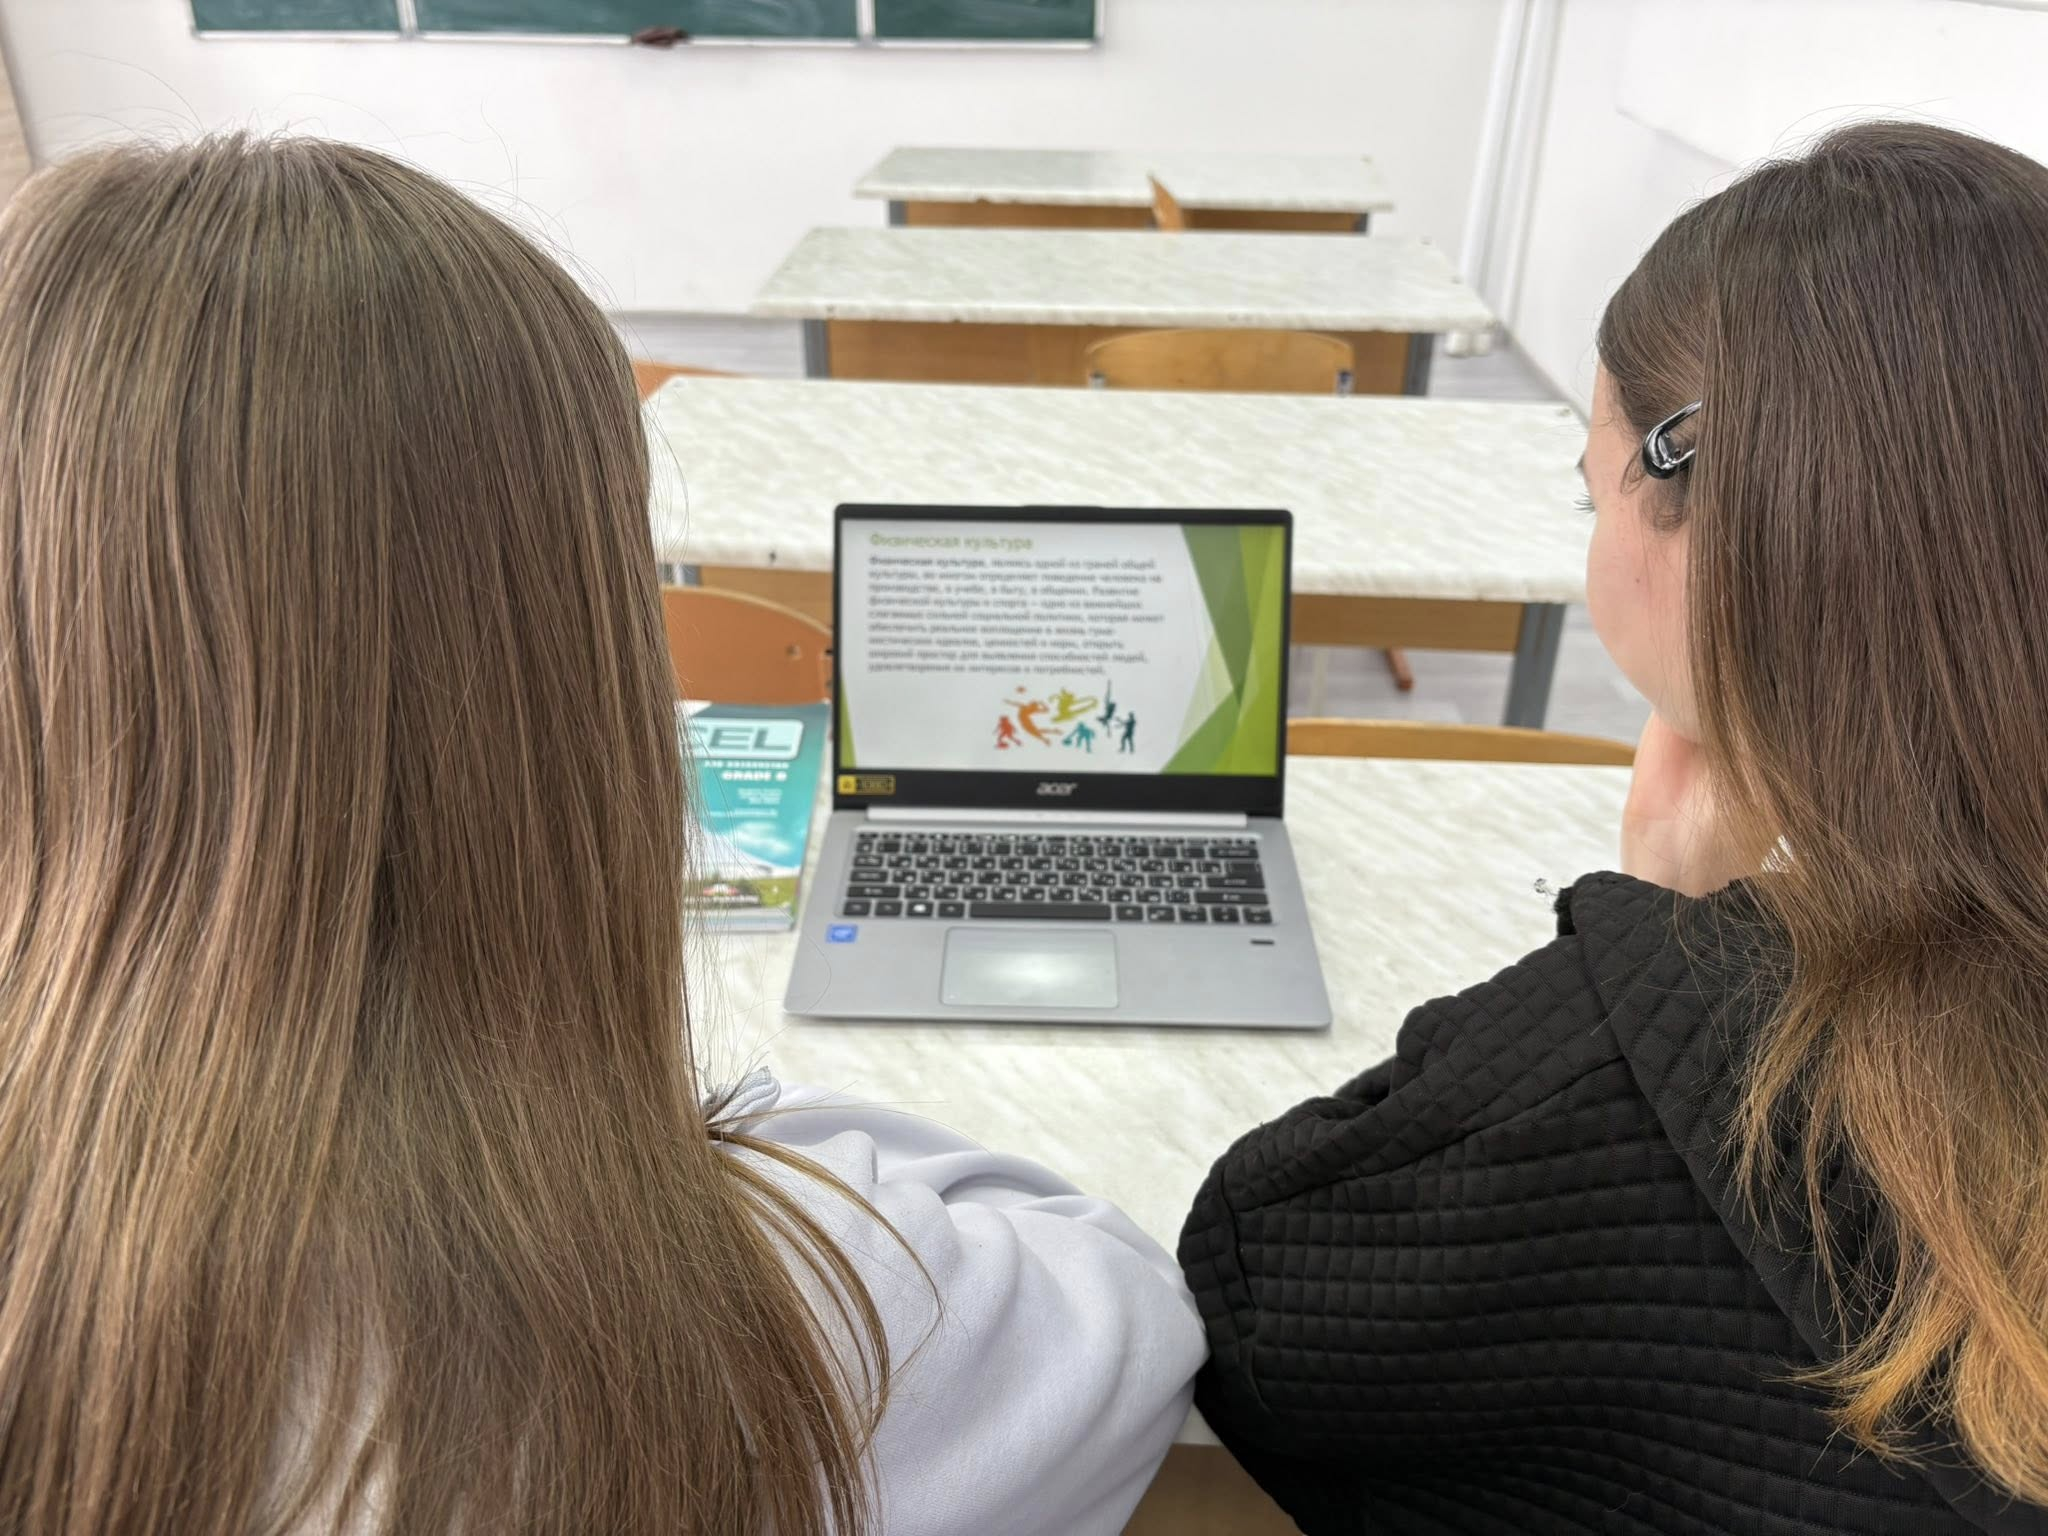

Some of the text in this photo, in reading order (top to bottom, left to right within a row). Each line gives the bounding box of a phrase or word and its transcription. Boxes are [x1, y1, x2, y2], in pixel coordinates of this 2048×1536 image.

[871, 534, 1033, 552] Физическая культура
[869, 554, 933, 565] Физическая
[1036, 782, 1077, 796] acer
